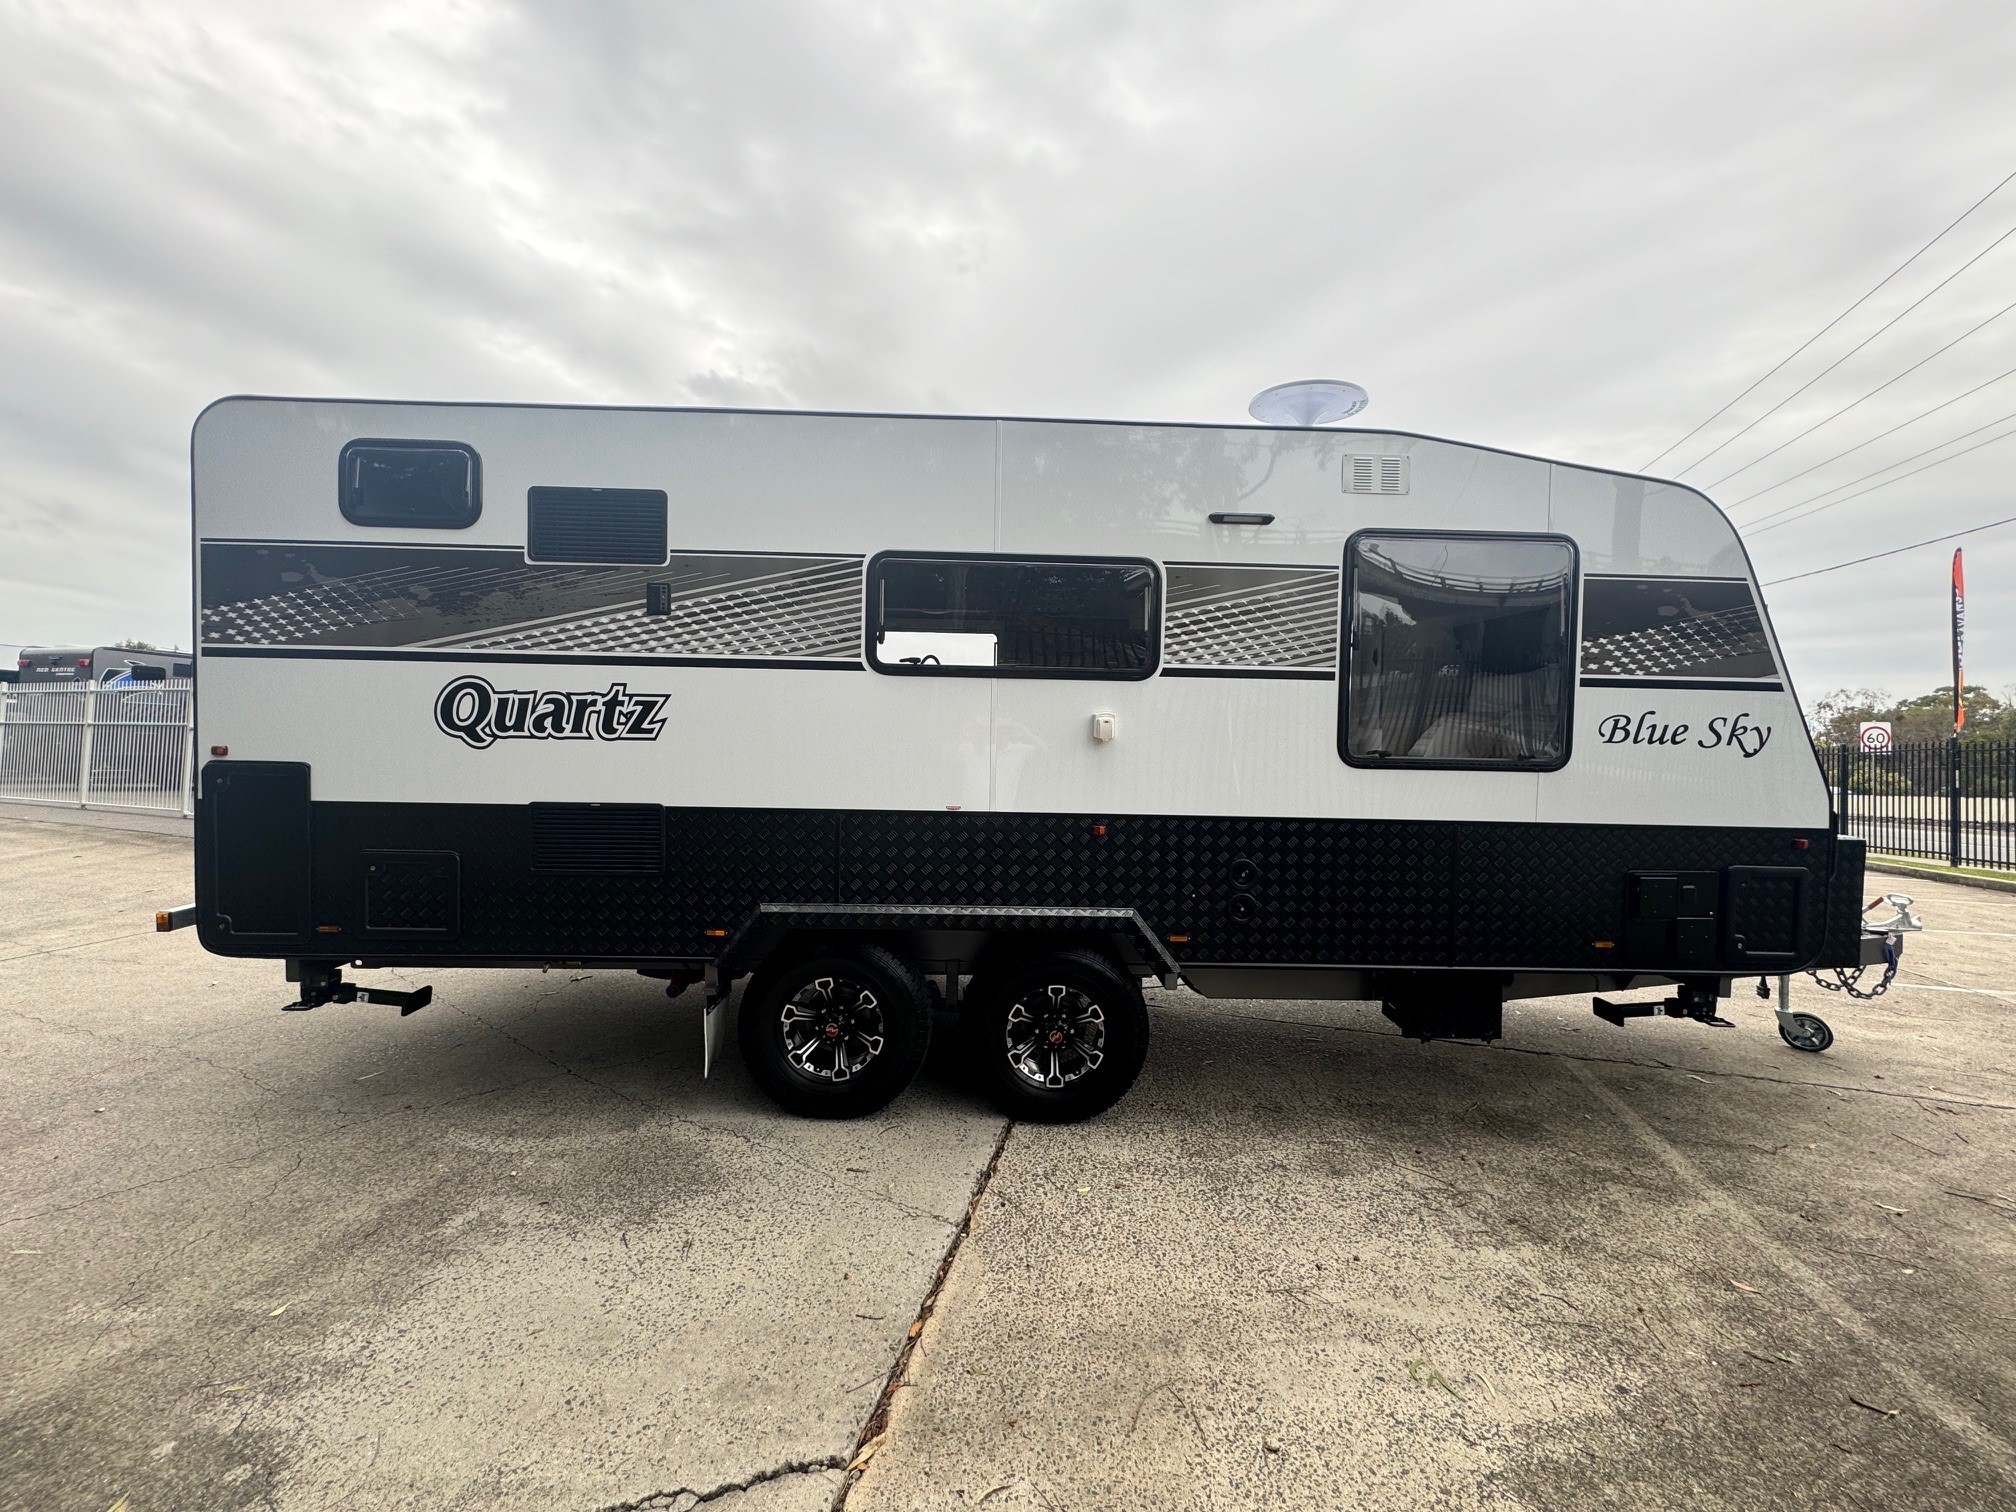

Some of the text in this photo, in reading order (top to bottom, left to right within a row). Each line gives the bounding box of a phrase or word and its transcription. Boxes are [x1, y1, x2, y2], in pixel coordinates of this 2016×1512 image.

[434, 675, 672, 750] Quartz
[1598, 710, 1772, 758] Blue Sky
[1866, 732, 1886, 744] 60
